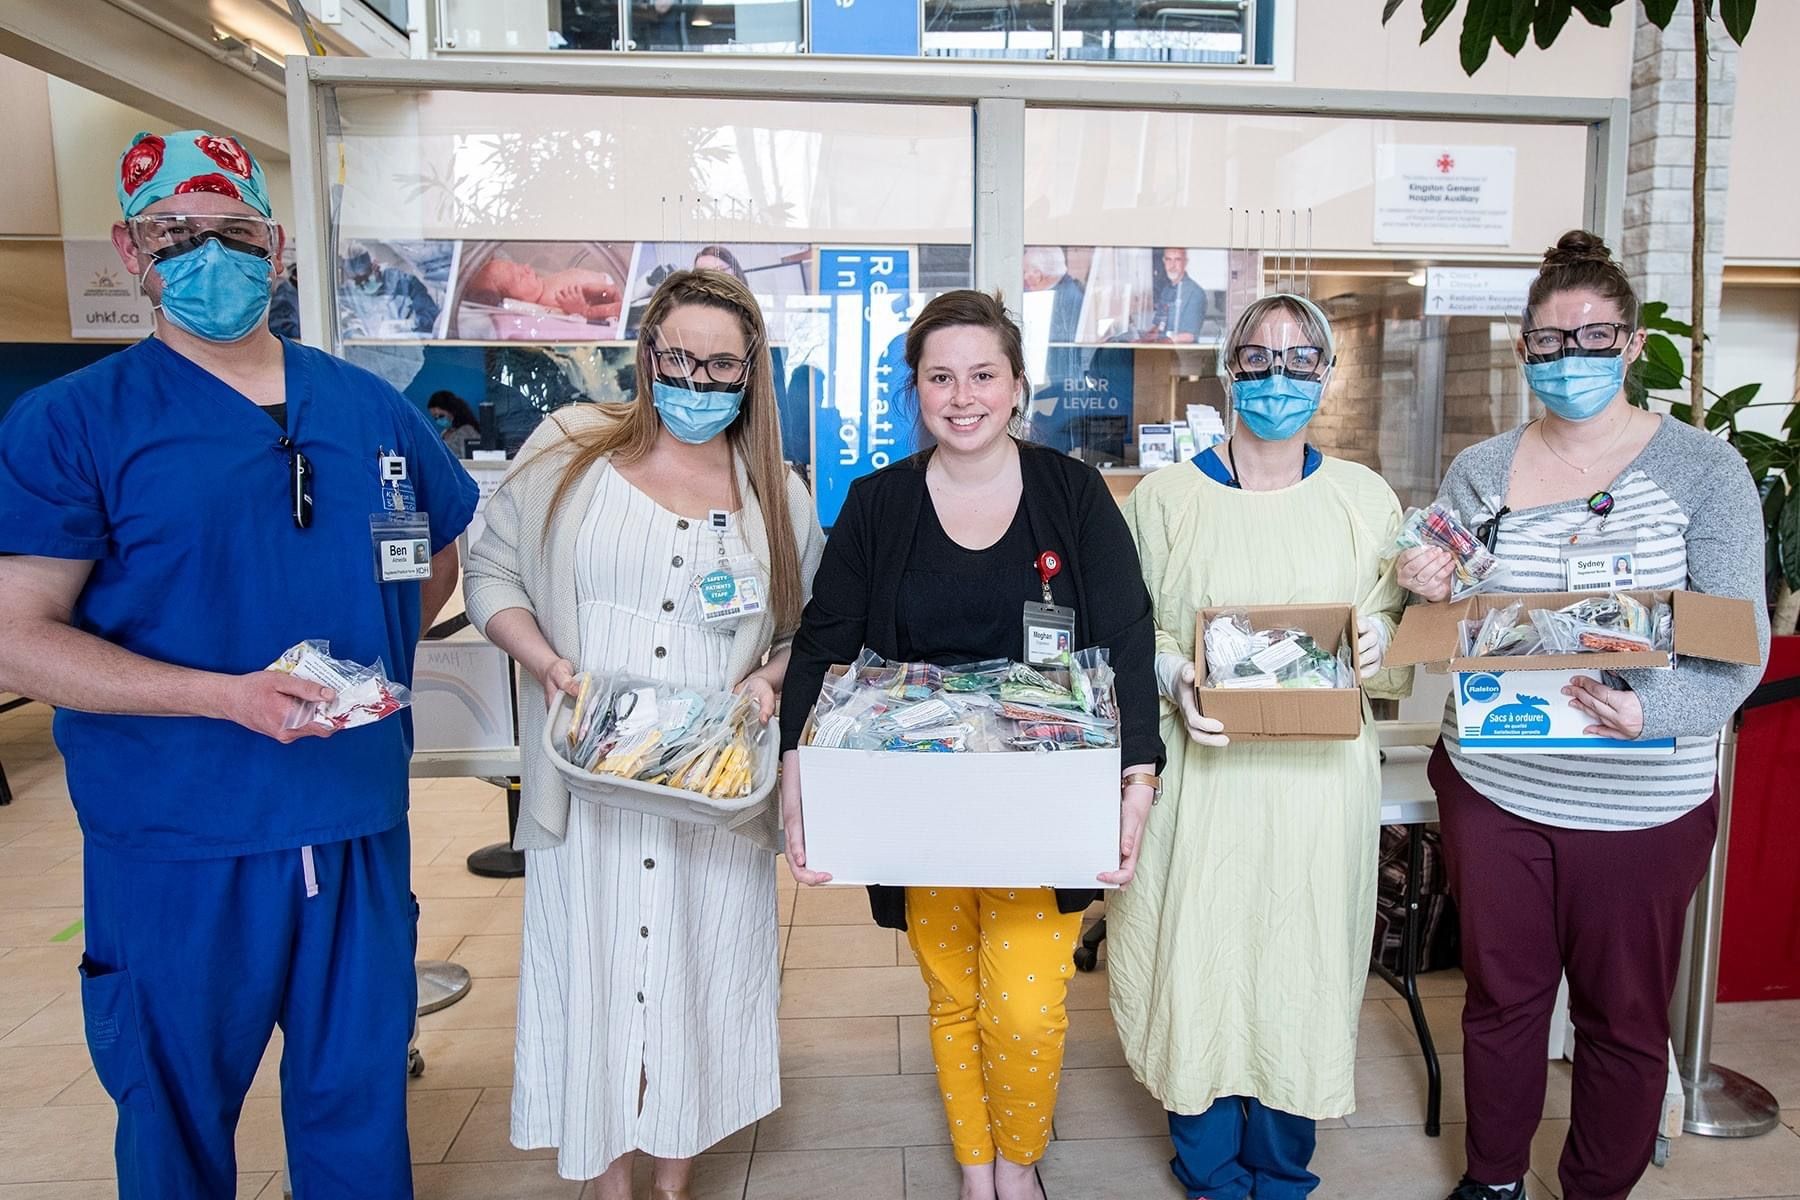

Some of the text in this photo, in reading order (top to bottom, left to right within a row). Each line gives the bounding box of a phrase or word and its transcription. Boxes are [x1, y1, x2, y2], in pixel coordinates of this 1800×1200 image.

[1409, 183, 1480, 193] Kingston General
[1408, 194, 1479, 204] Hospital Auxiliary
[86, 310, 140, 324] uhkf.ca
[1064, 397, 1105, 409] LEVEL
[390, 545, 407, 556] Ben
[1577, 560, 1605, 569] Sydney
[1489, 713, 1507, 722] Sacs
[1508, 712, 1514, 722] à
